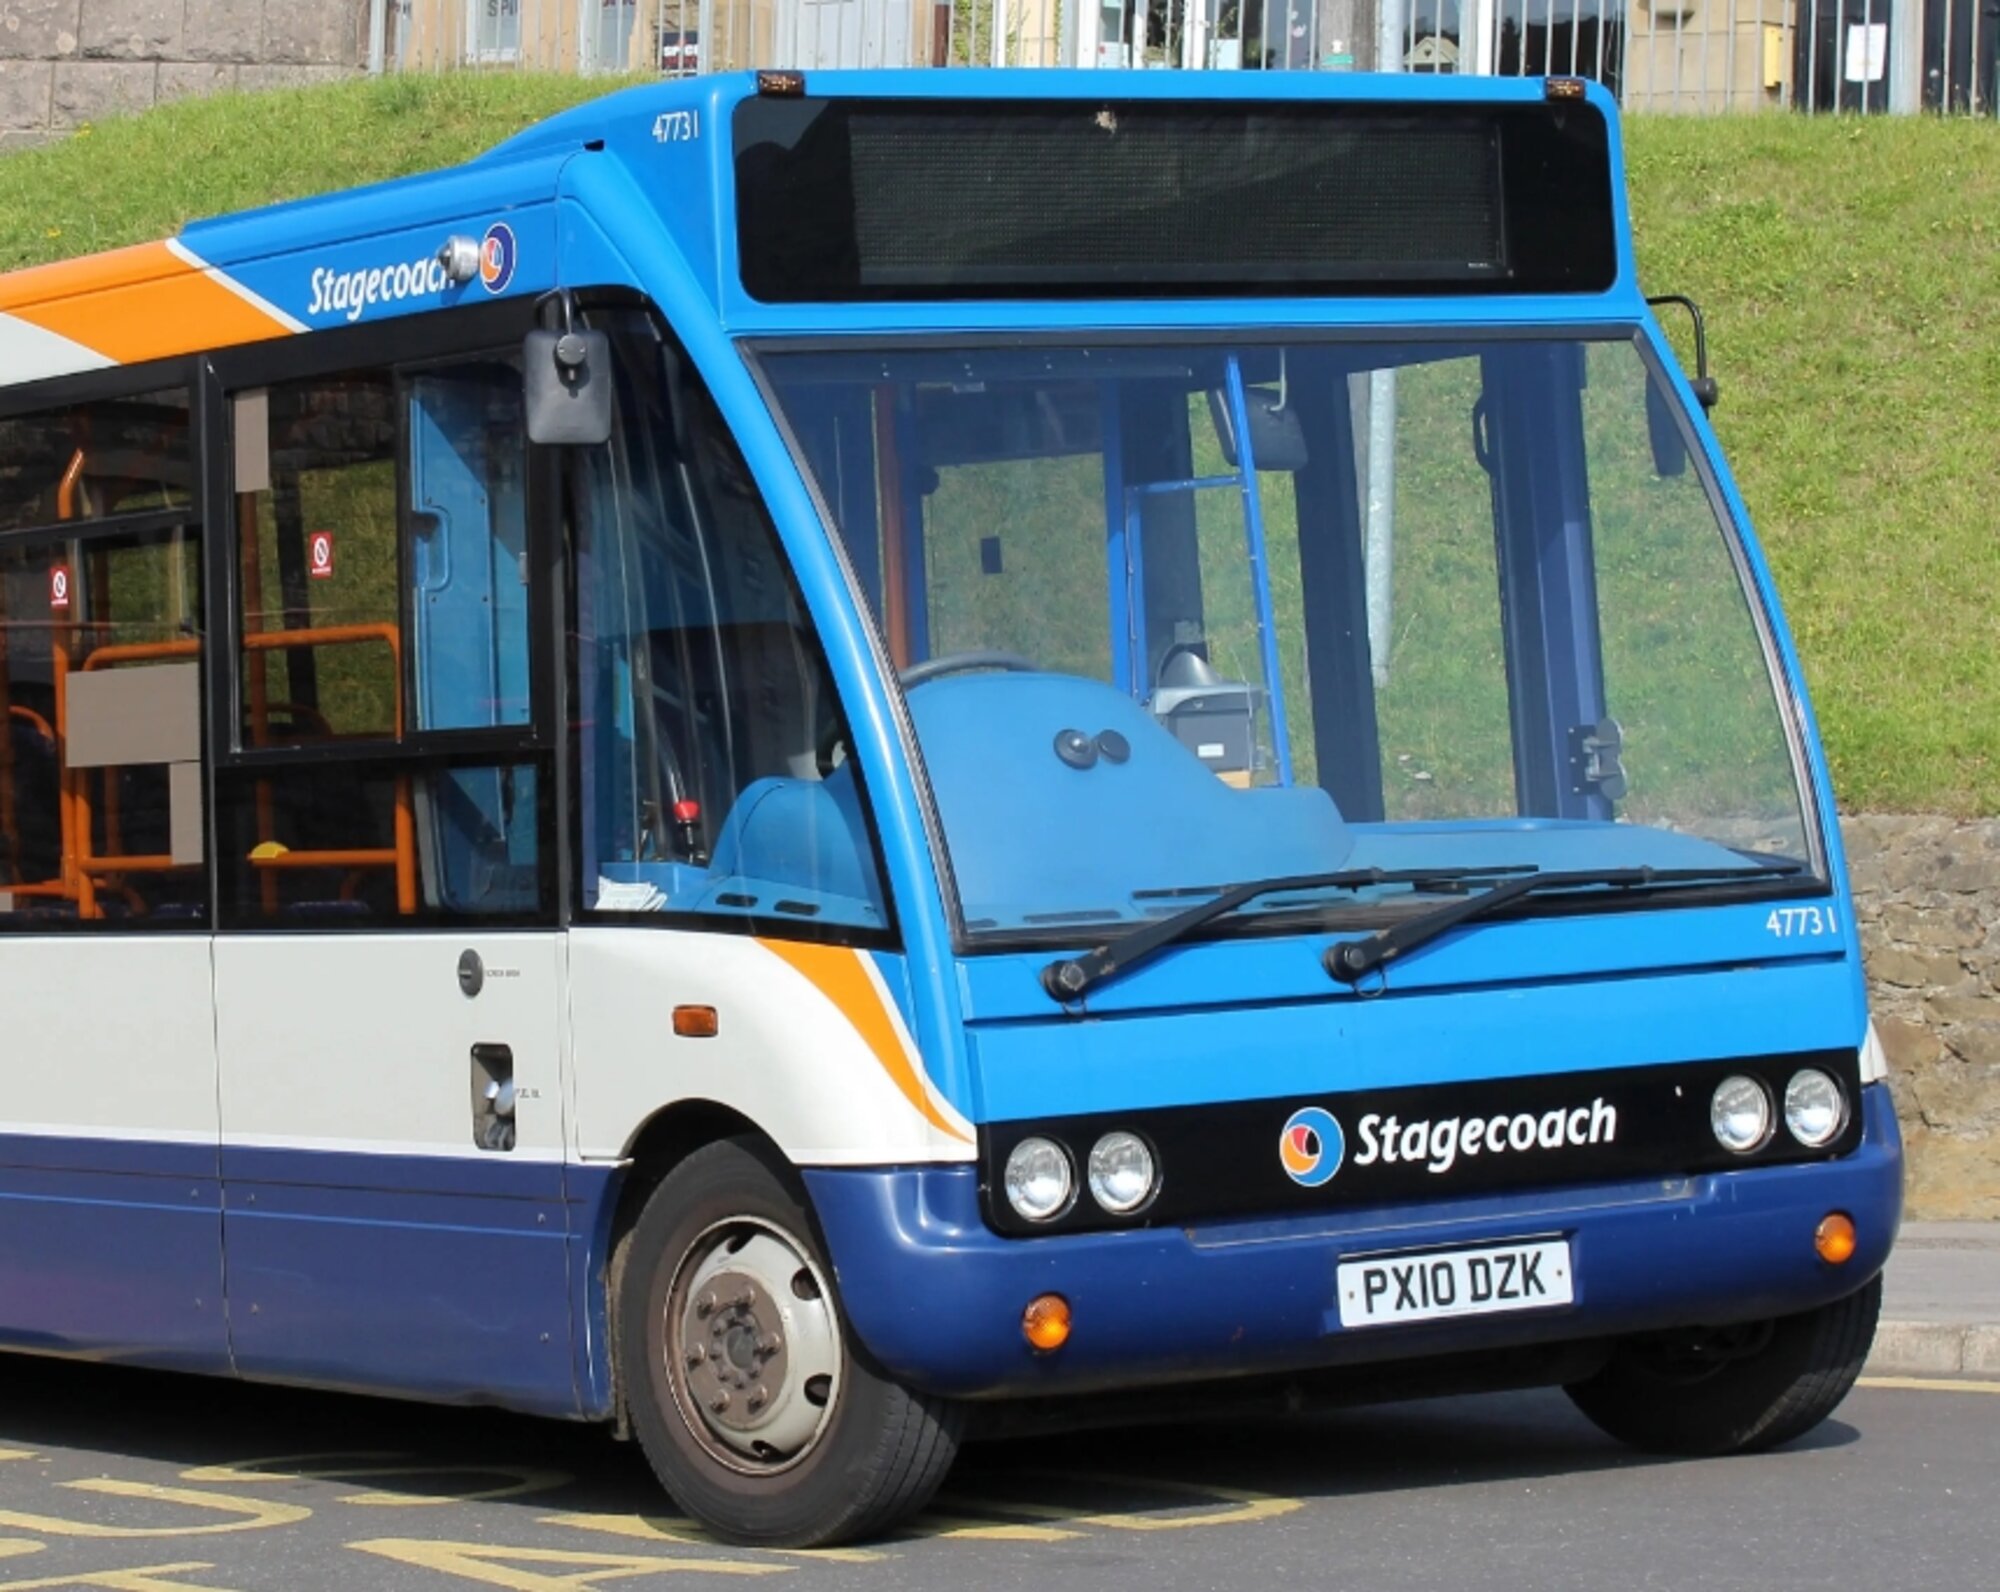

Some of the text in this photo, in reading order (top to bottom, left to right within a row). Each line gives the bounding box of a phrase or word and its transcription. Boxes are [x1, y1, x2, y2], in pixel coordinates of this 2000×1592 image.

[652, 109, 699, 143] 47731
[1766, 906, 1837, 938] 47731
[1353, 1097, 1617, 1173] Stagecoach
[1363, 1251, 1546, 1313] PX10 DZK
